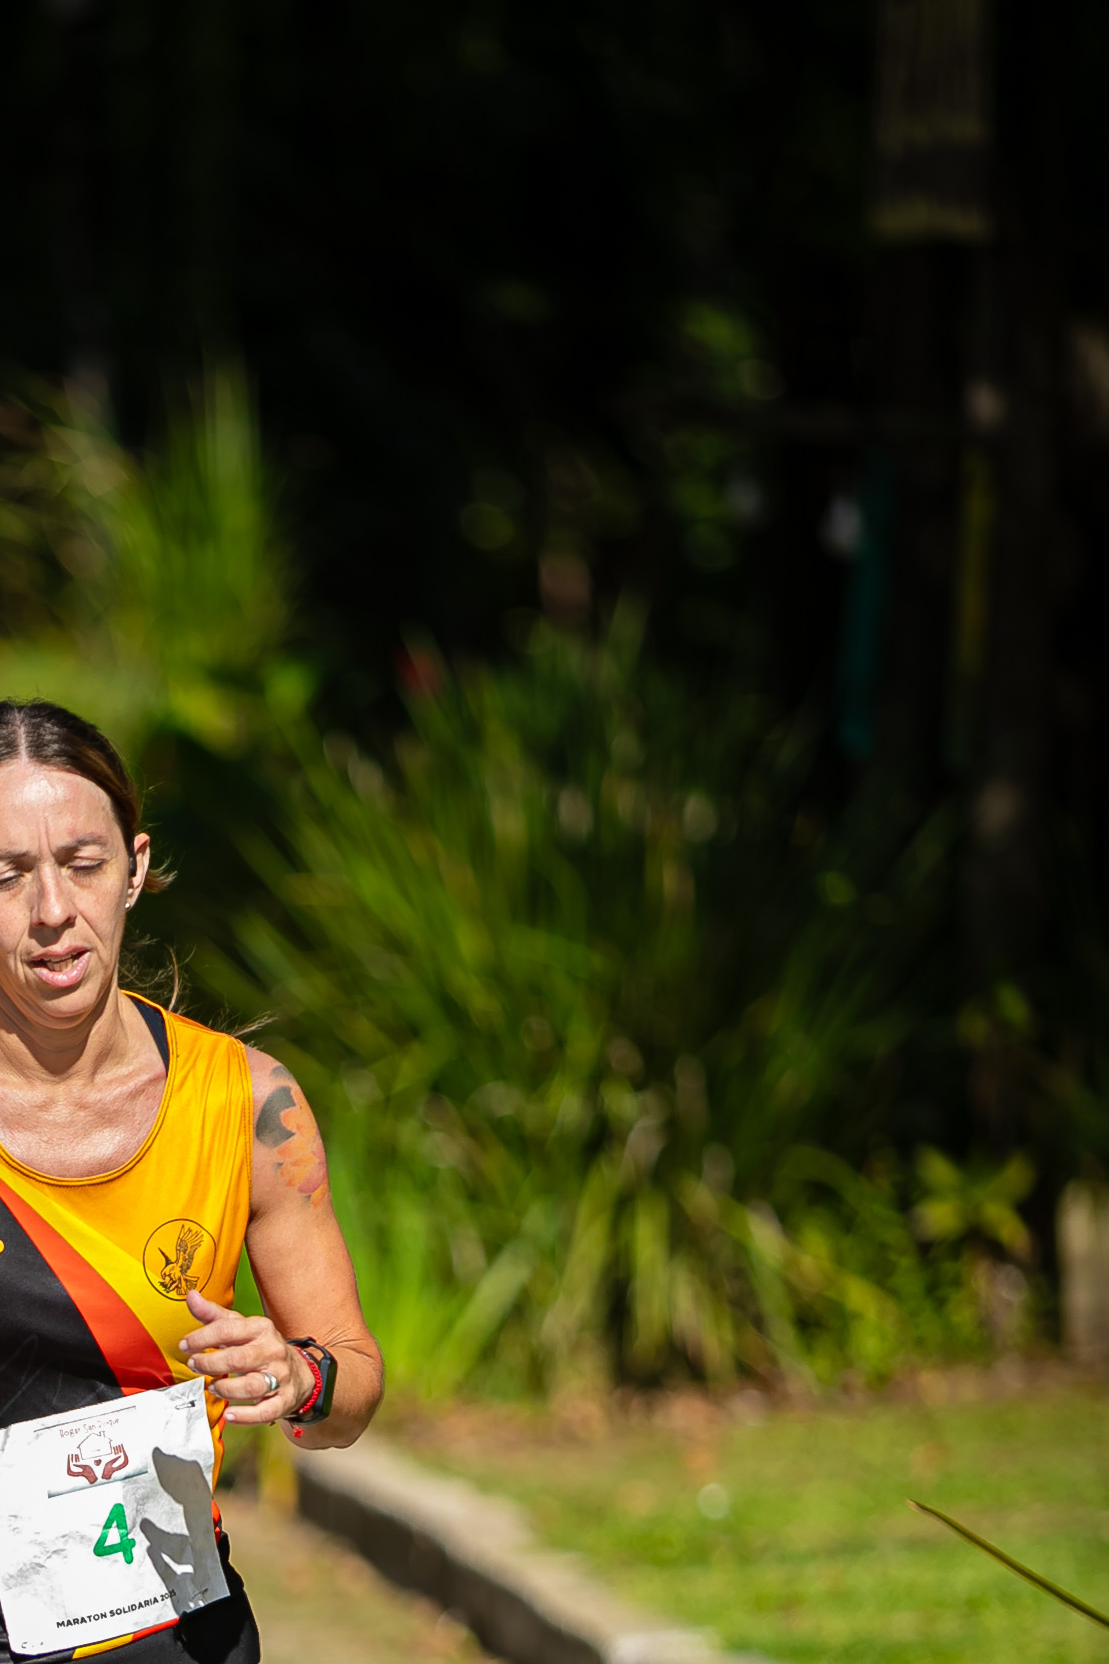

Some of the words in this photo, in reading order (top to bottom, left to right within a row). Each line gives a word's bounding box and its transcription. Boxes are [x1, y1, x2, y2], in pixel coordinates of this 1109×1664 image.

[93, 1502, 136, 1565] 4
[56, 1611, 108, 1628] MARATON
[109, 1597, 159, 1617] SOLIDARIA
